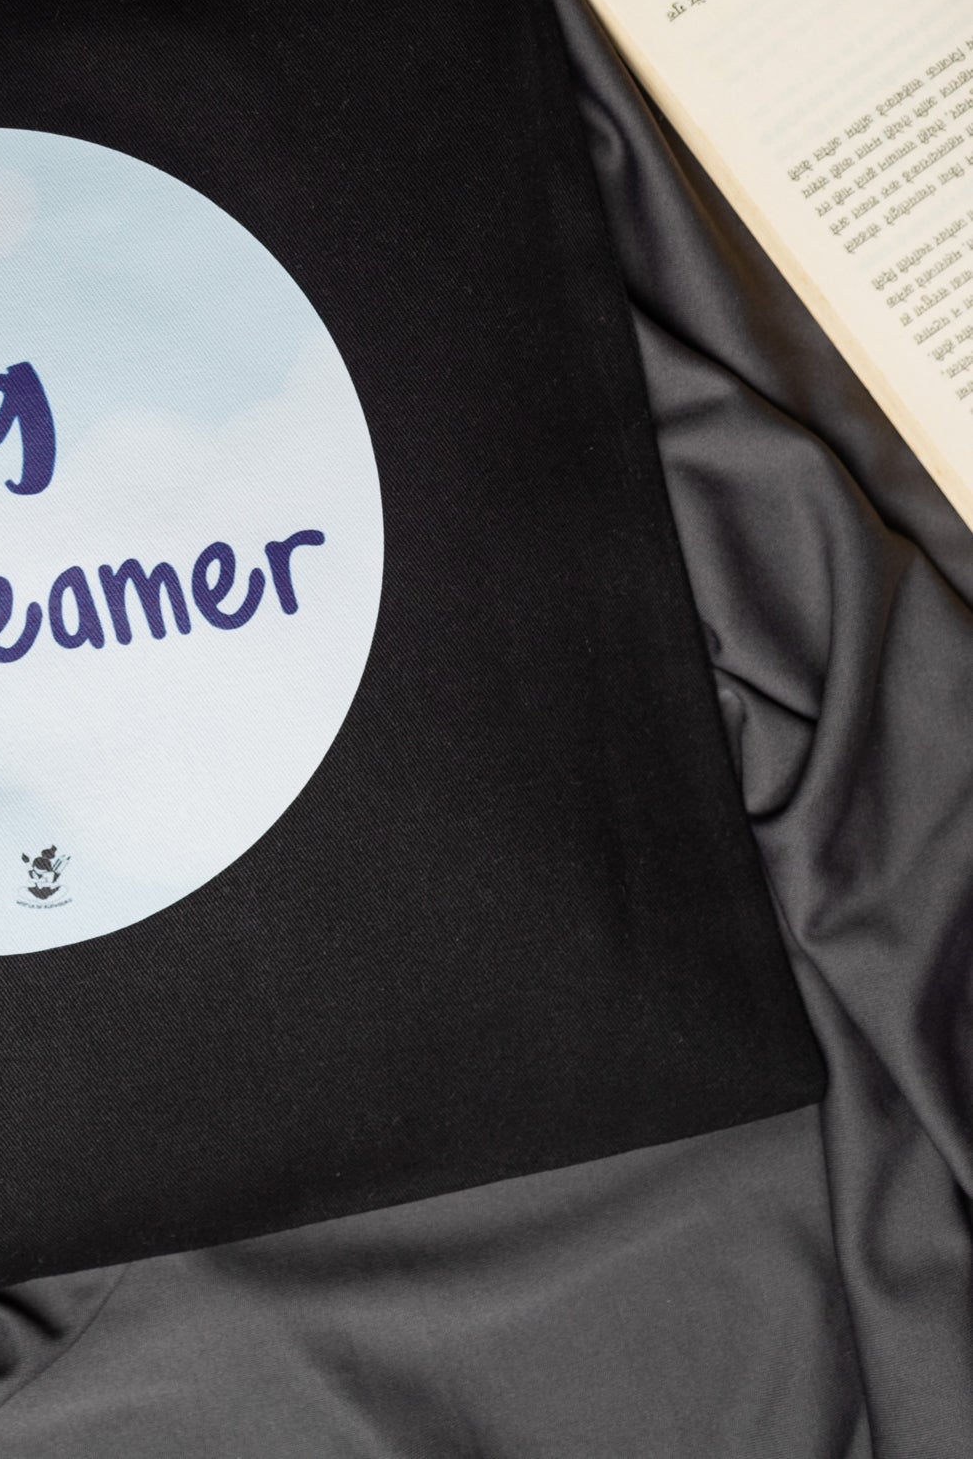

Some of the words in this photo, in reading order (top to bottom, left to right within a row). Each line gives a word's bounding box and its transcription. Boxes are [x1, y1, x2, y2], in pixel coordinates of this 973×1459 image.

[912, 96, 939, 119] आणि
[854, 136, 884, 161] मनात
[877, 140, 918, 173] समाधान
[814, 201, 834, 218] तर
